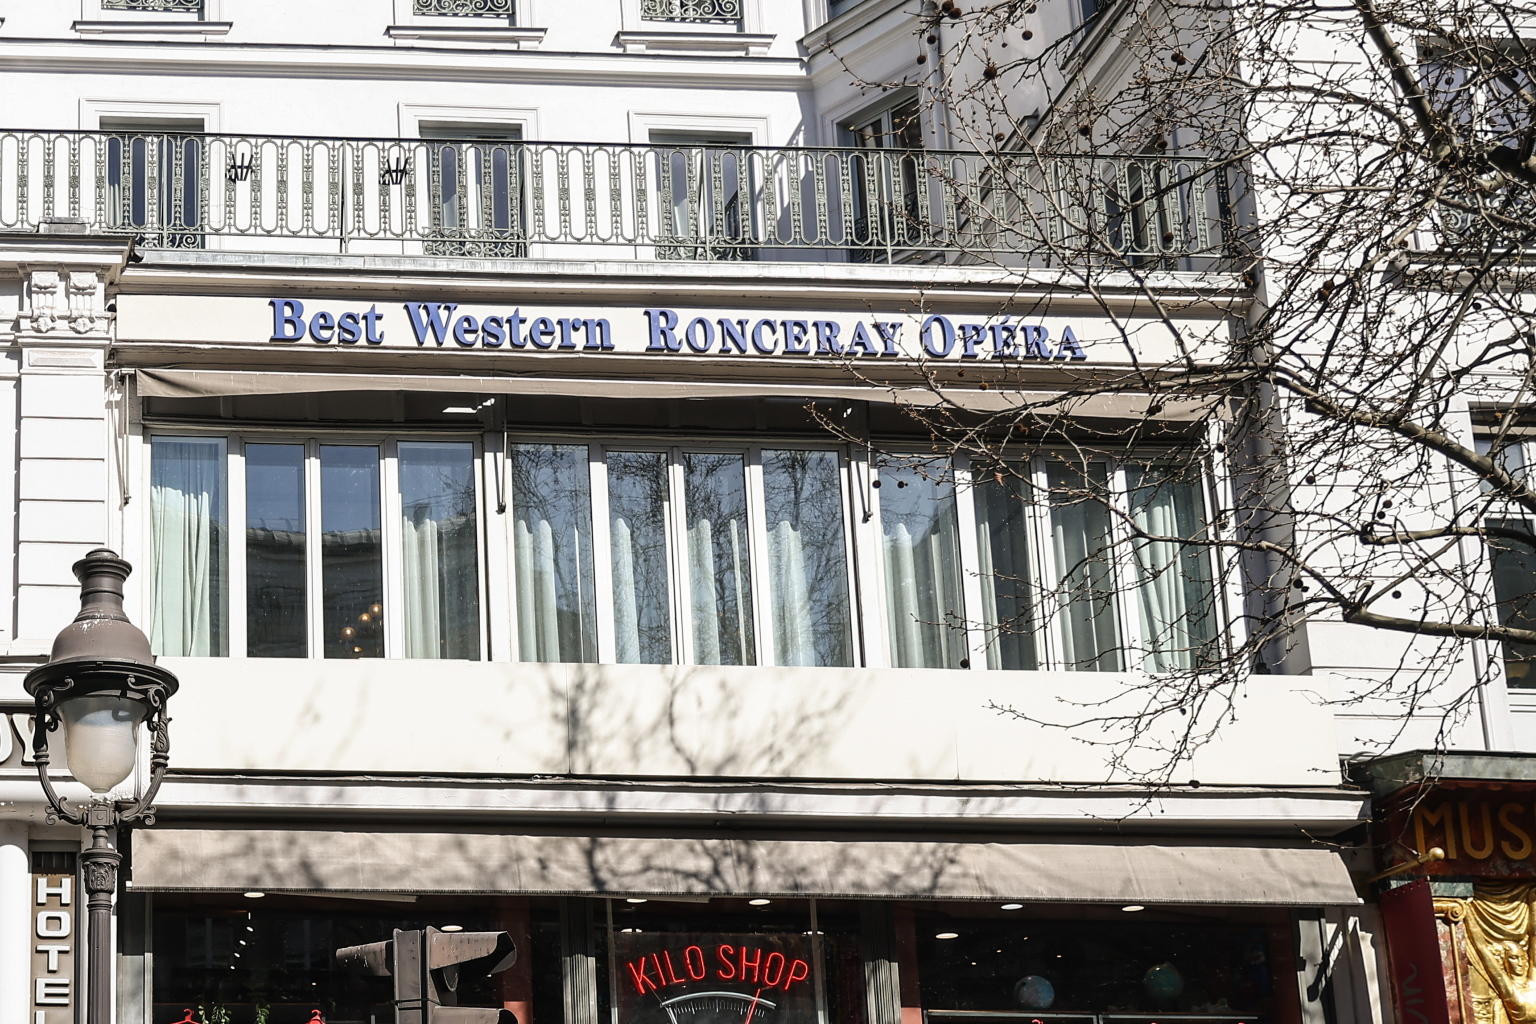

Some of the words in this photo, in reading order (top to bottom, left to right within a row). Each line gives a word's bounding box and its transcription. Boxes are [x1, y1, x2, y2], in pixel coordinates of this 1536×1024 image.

[268, 299, 385, 344] Best
[403, 301, 615, 351] Western
[643, 308, 902, 357] RONCERAY
[919, 313, 1088, 361] OPÉRA
[628, 945, 706, 995] KILO
[716, 944, 809, 991] SHOP
